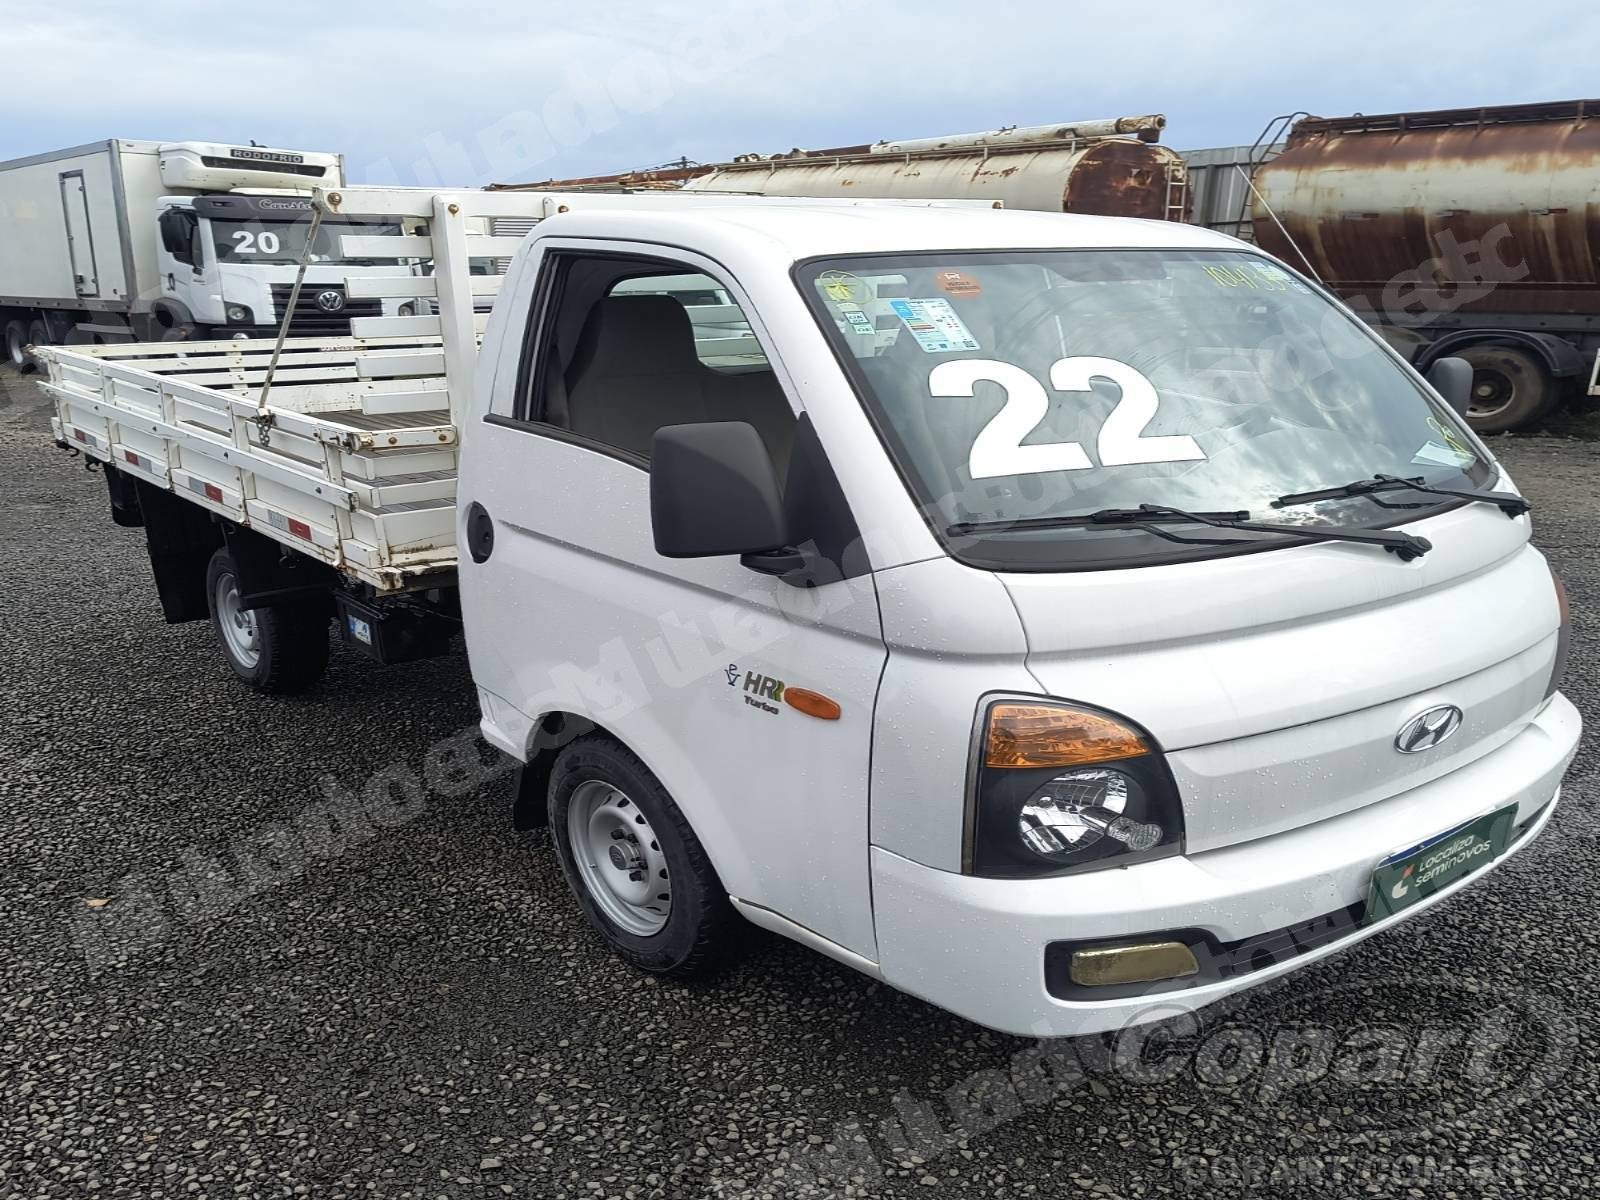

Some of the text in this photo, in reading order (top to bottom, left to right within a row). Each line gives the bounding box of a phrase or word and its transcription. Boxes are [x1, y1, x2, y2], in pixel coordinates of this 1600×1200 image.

[233, 150, 302, 163] RODOFRIO
[232, 231, 280, 254] 20
[928, 356, 1208, 479] 22
[1415, 840, 1492, 888] seminovos
[1418, 834, 1475, 873] Localiza
